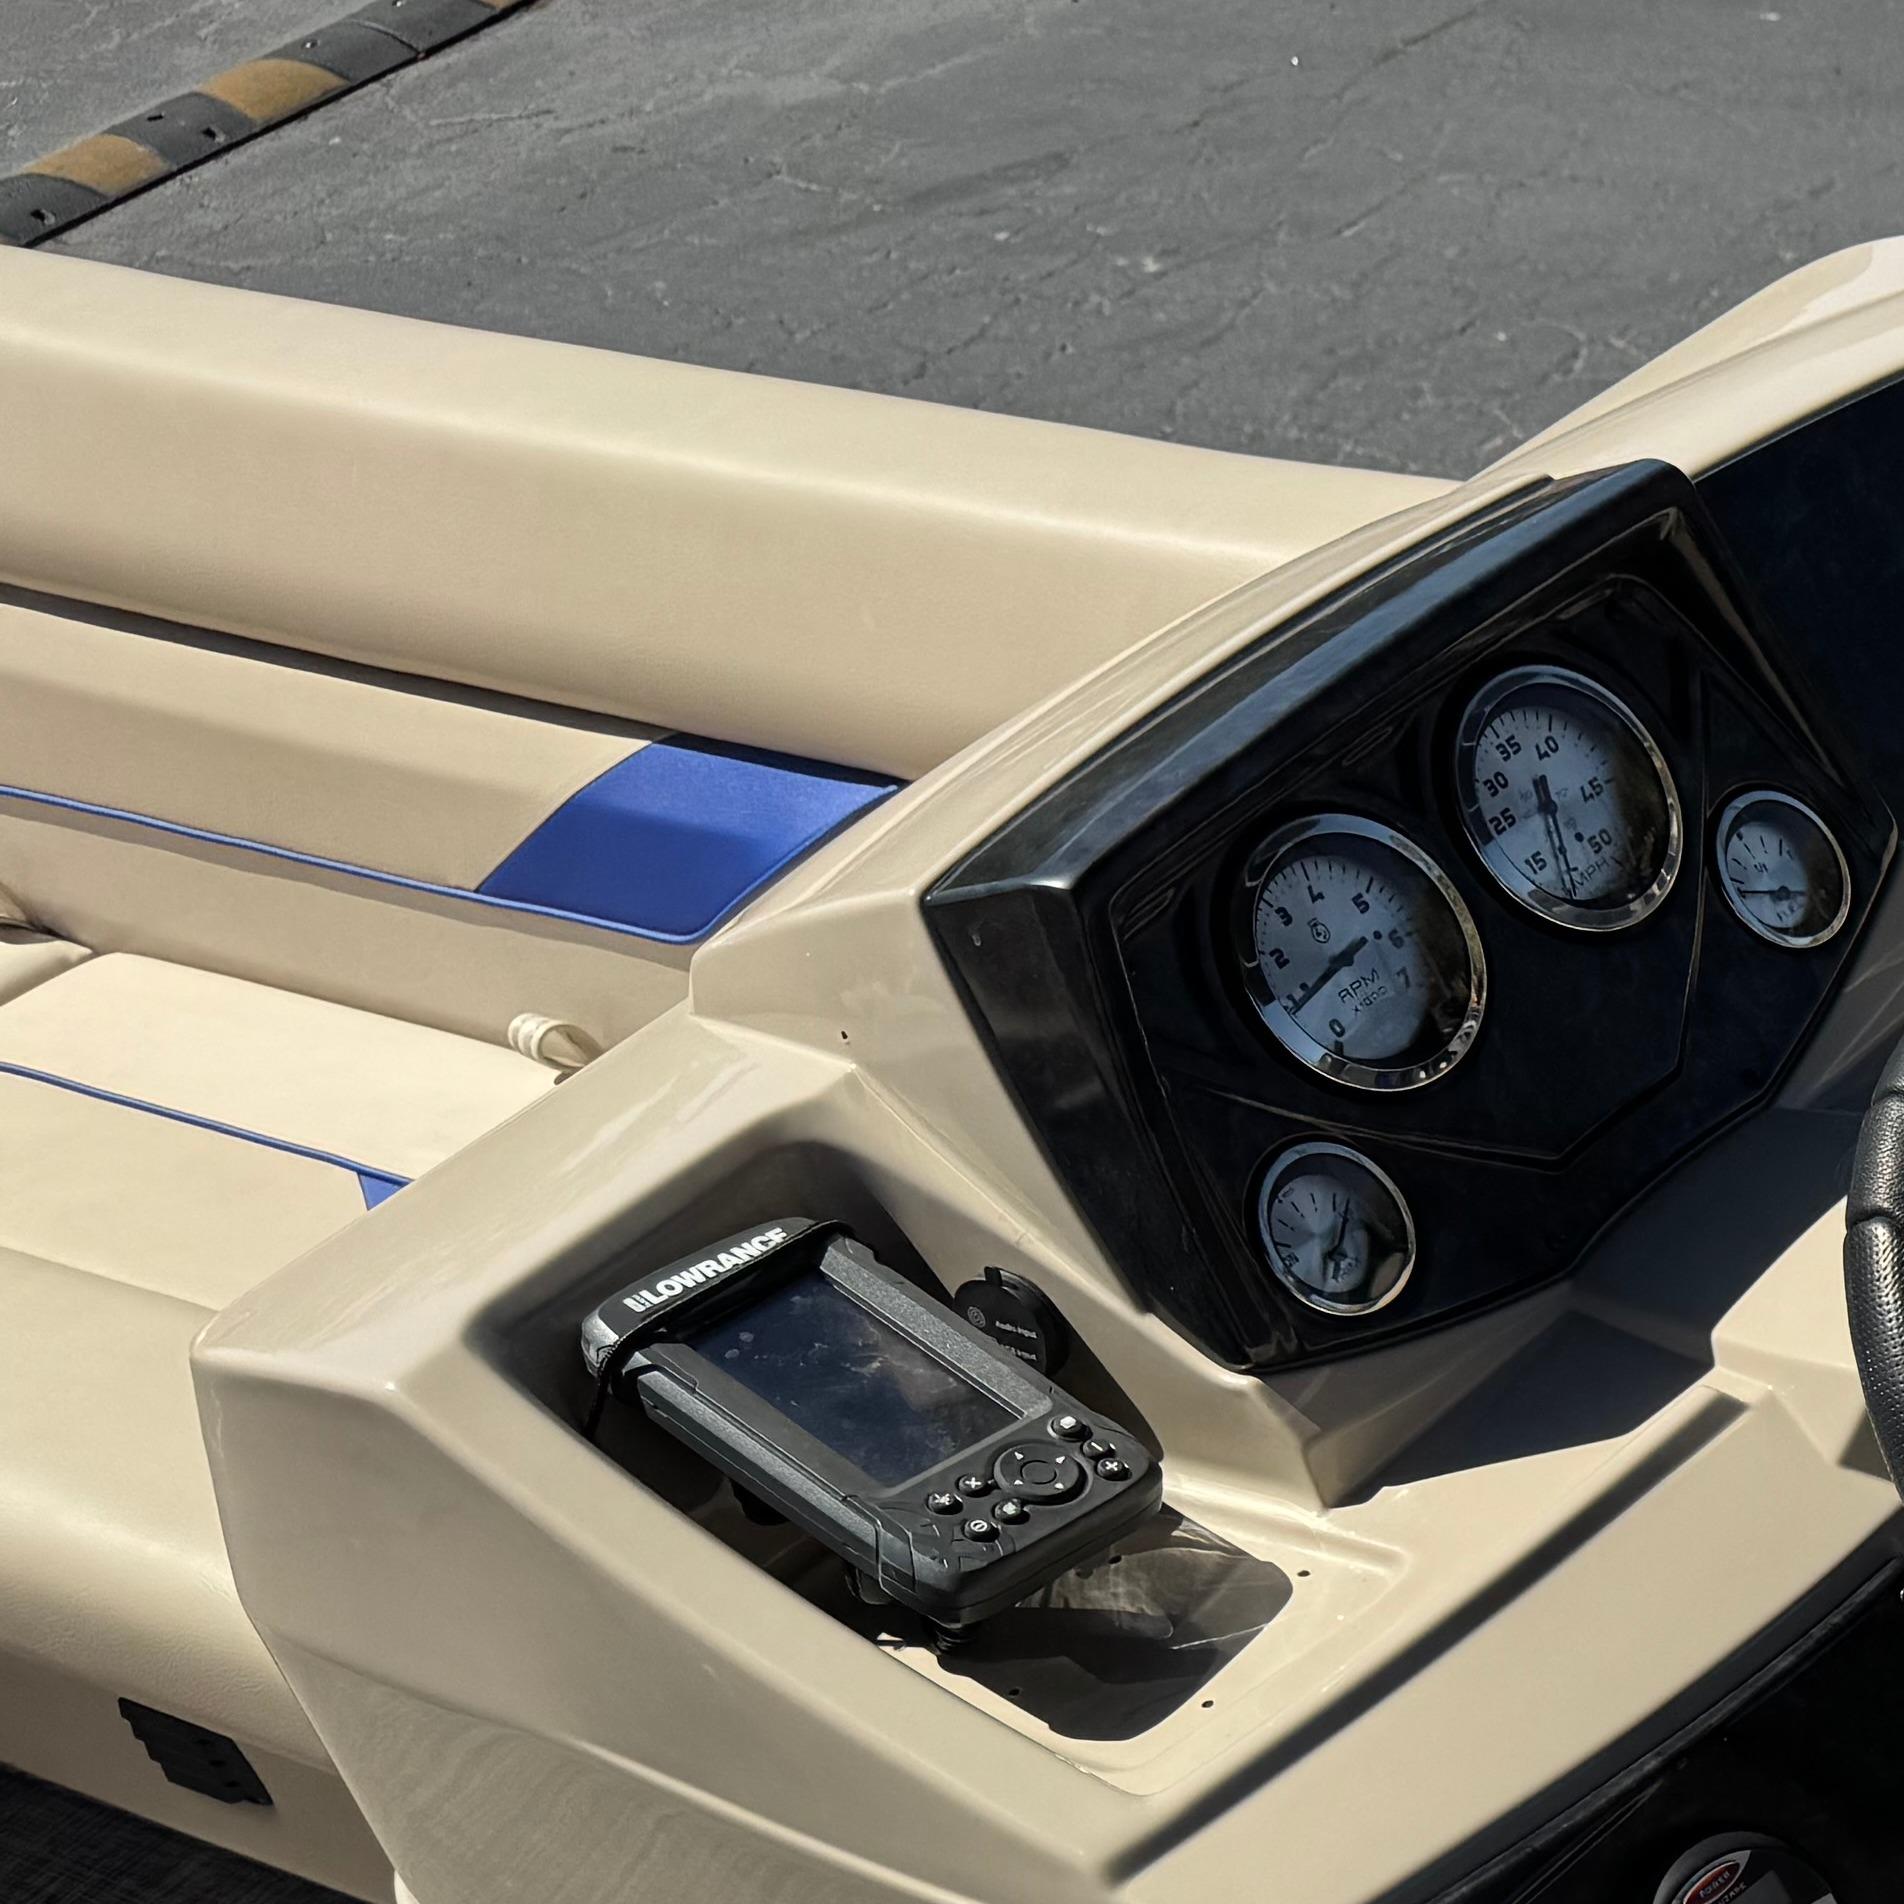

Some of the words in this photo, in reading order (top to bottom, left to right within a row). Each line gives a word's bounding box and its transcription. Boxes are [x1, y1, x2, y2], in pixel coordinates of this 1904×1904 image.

[1495, 735, 1521, 761] 35
[1535, 736, 1559, 760] 40
[1484, 771, 1508, 797] 30
[1580, 777, 1603, 802] 45
[1489, 807, 1516, 835] 25
[1587, 828, 1612, 853] 50
[1524, 850, 1547, 874] 15
[1573, 859, 1610, 888] MPH
[1308, 885, 1324, 903] 4
[1352, 892, 1369, 913] 5
[1274, 906, 1292, 926] 3
[1388, 928, 1404, 948] 6
[1270, 947, 1289, 969] 2
[1338, 968, 1379, 1003] RPM
[1329, 1018, 1345, 1037] 0
[639, 1227, 788, 1305] LOWRANCE
